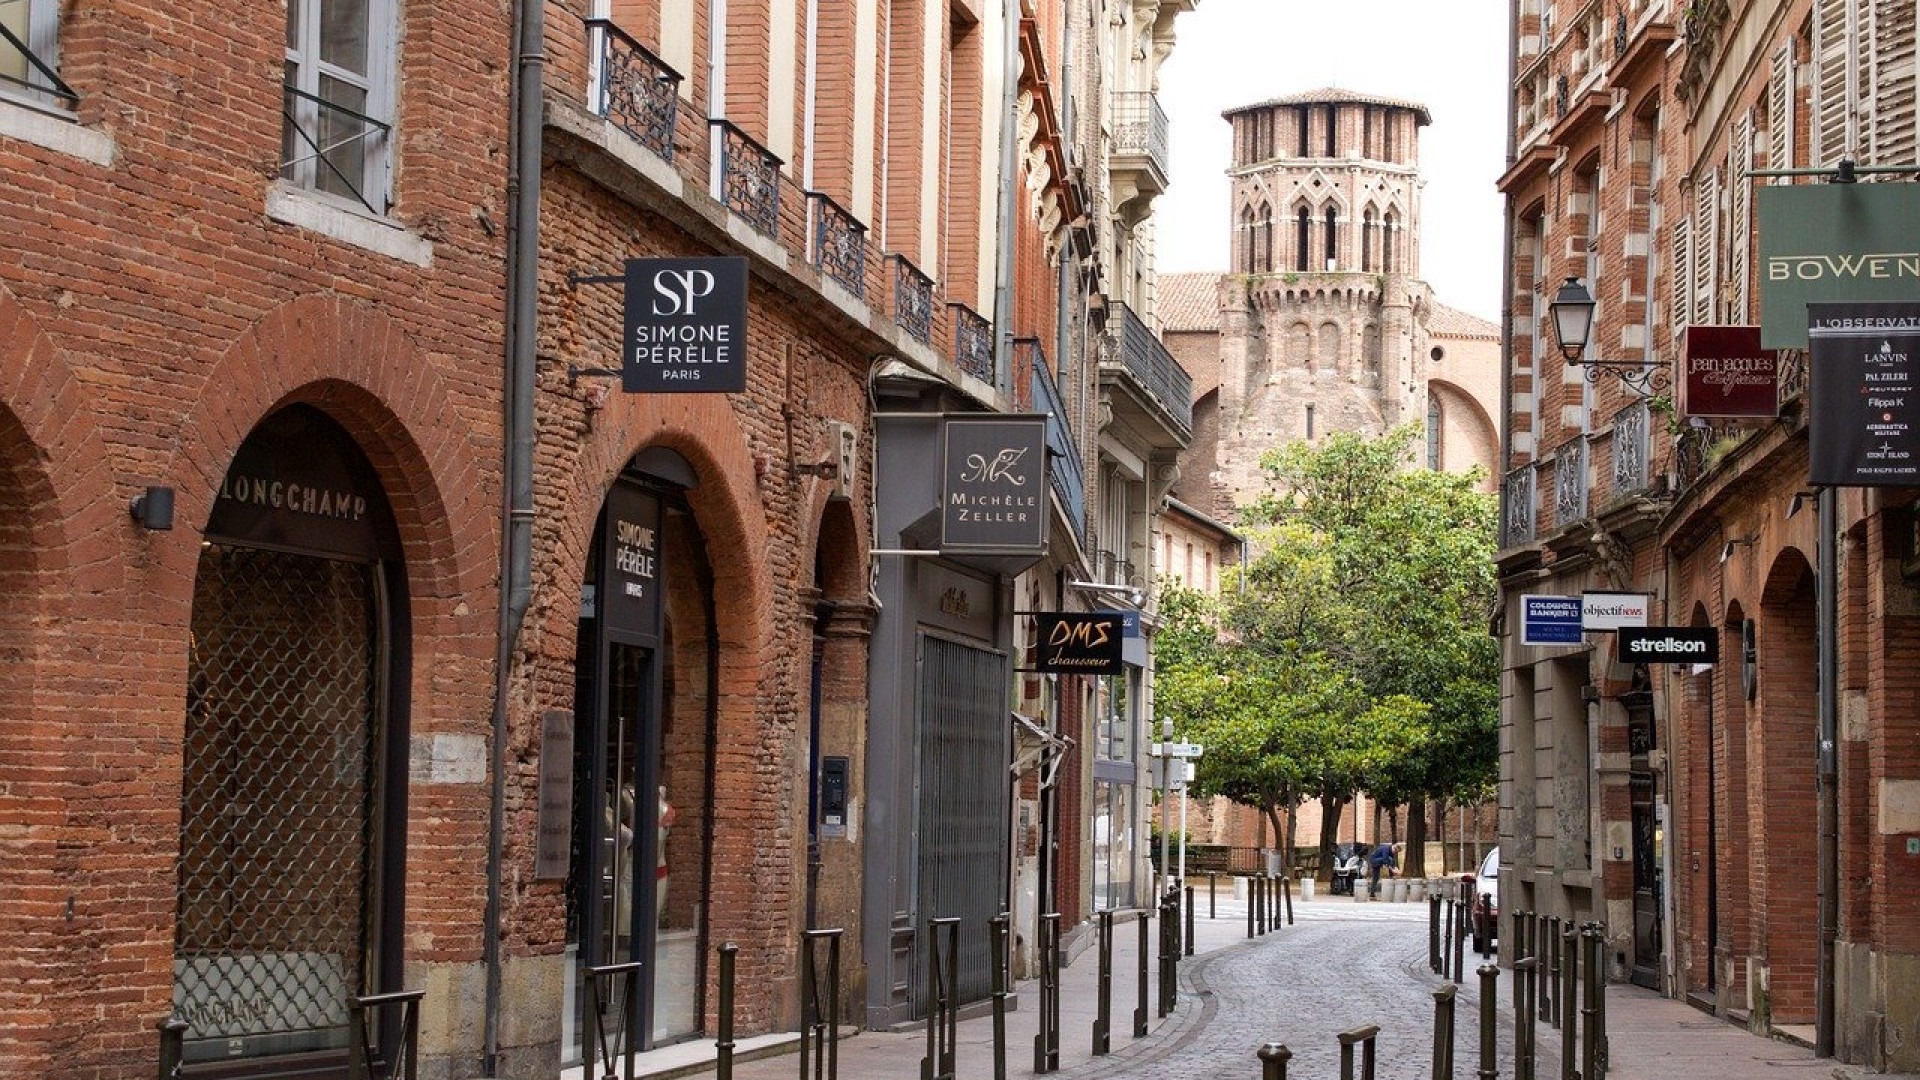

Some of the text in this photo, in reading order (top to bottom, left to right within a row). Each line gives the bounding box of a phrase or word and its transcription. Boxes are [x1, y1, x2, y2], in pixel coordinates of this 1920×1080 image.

[1768, 253, 1920, 281] BOWEN
[651, 269, 715, 316] SP
[1815, 317, 1920, 330] L'OBSERVAT
[636, 324, 730, 343] SIMONE
[635, 342, 730, 364] PÉRÈLE
[1864, 353, 1908, 363] LANVIN
[662, 369, 701, 381] PARIS
[1865, 372, 1908, 381] PAL ZILERI
[1896, 398, 1904, 407] K
[221, 475, 366, 520] LONGCHAMP
[617, 519, 655, 551] SIMONE
[1049, 620, 1113, 649] DMS
[1630, 637, 1707, 653] strellson
